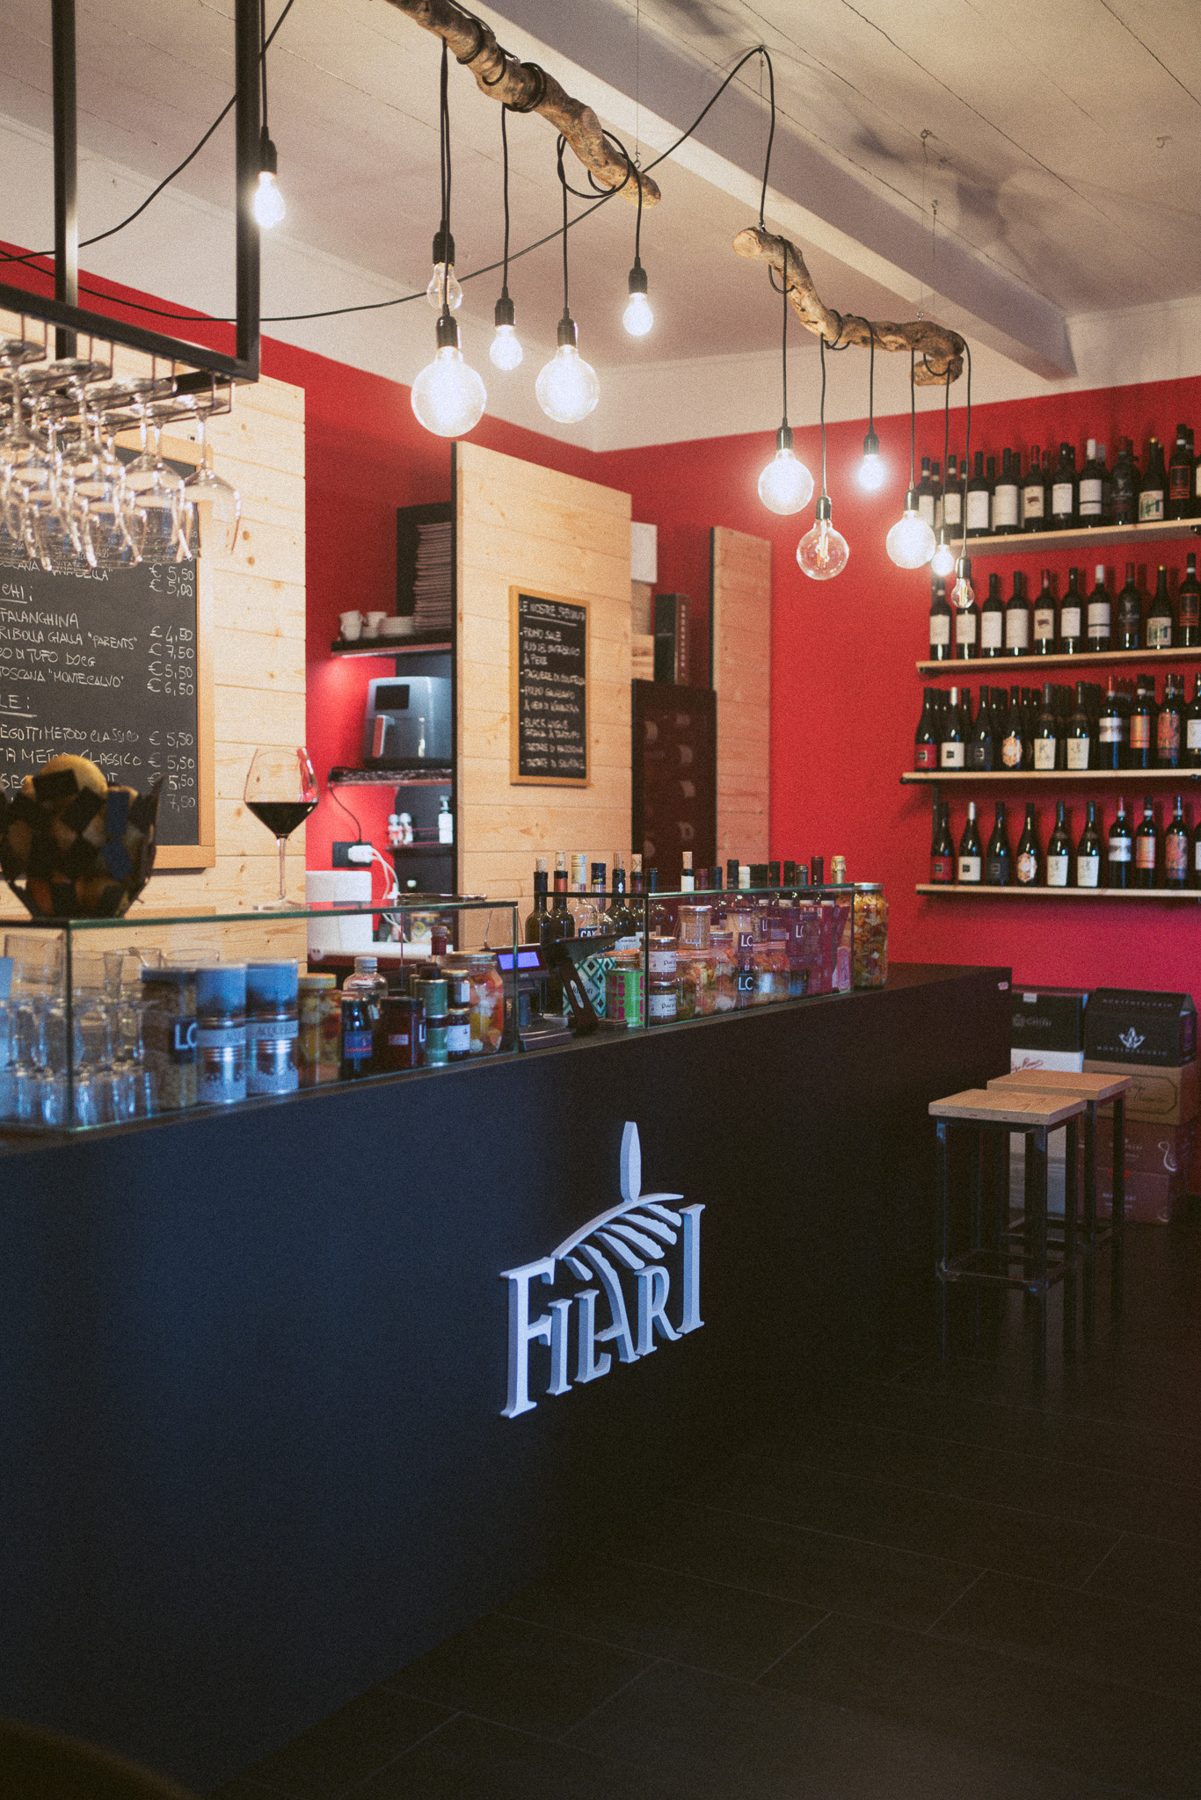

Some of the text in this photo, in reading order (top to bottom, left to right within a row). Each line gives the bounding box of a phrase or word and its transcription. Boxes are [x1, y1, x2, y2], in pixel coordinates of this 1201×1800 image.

[167, 566, 194, 583] 5,50
[165, 625, 194, 644] 4,50
[165, 644, 195, 660] 7,50
[26, 648, 59, 664] TUFO
[165, 664, 193, 680] 5,50
[164, 681, 195, 697] 6,50
[166, 731, 194, 749] 5,50
[167, 755, 195, 773] 5,50
[168, 774, 195, 791] 5,50
[166, 793, 196, 812] 7,50
[499, 1203, 706, 1419] FILARI
